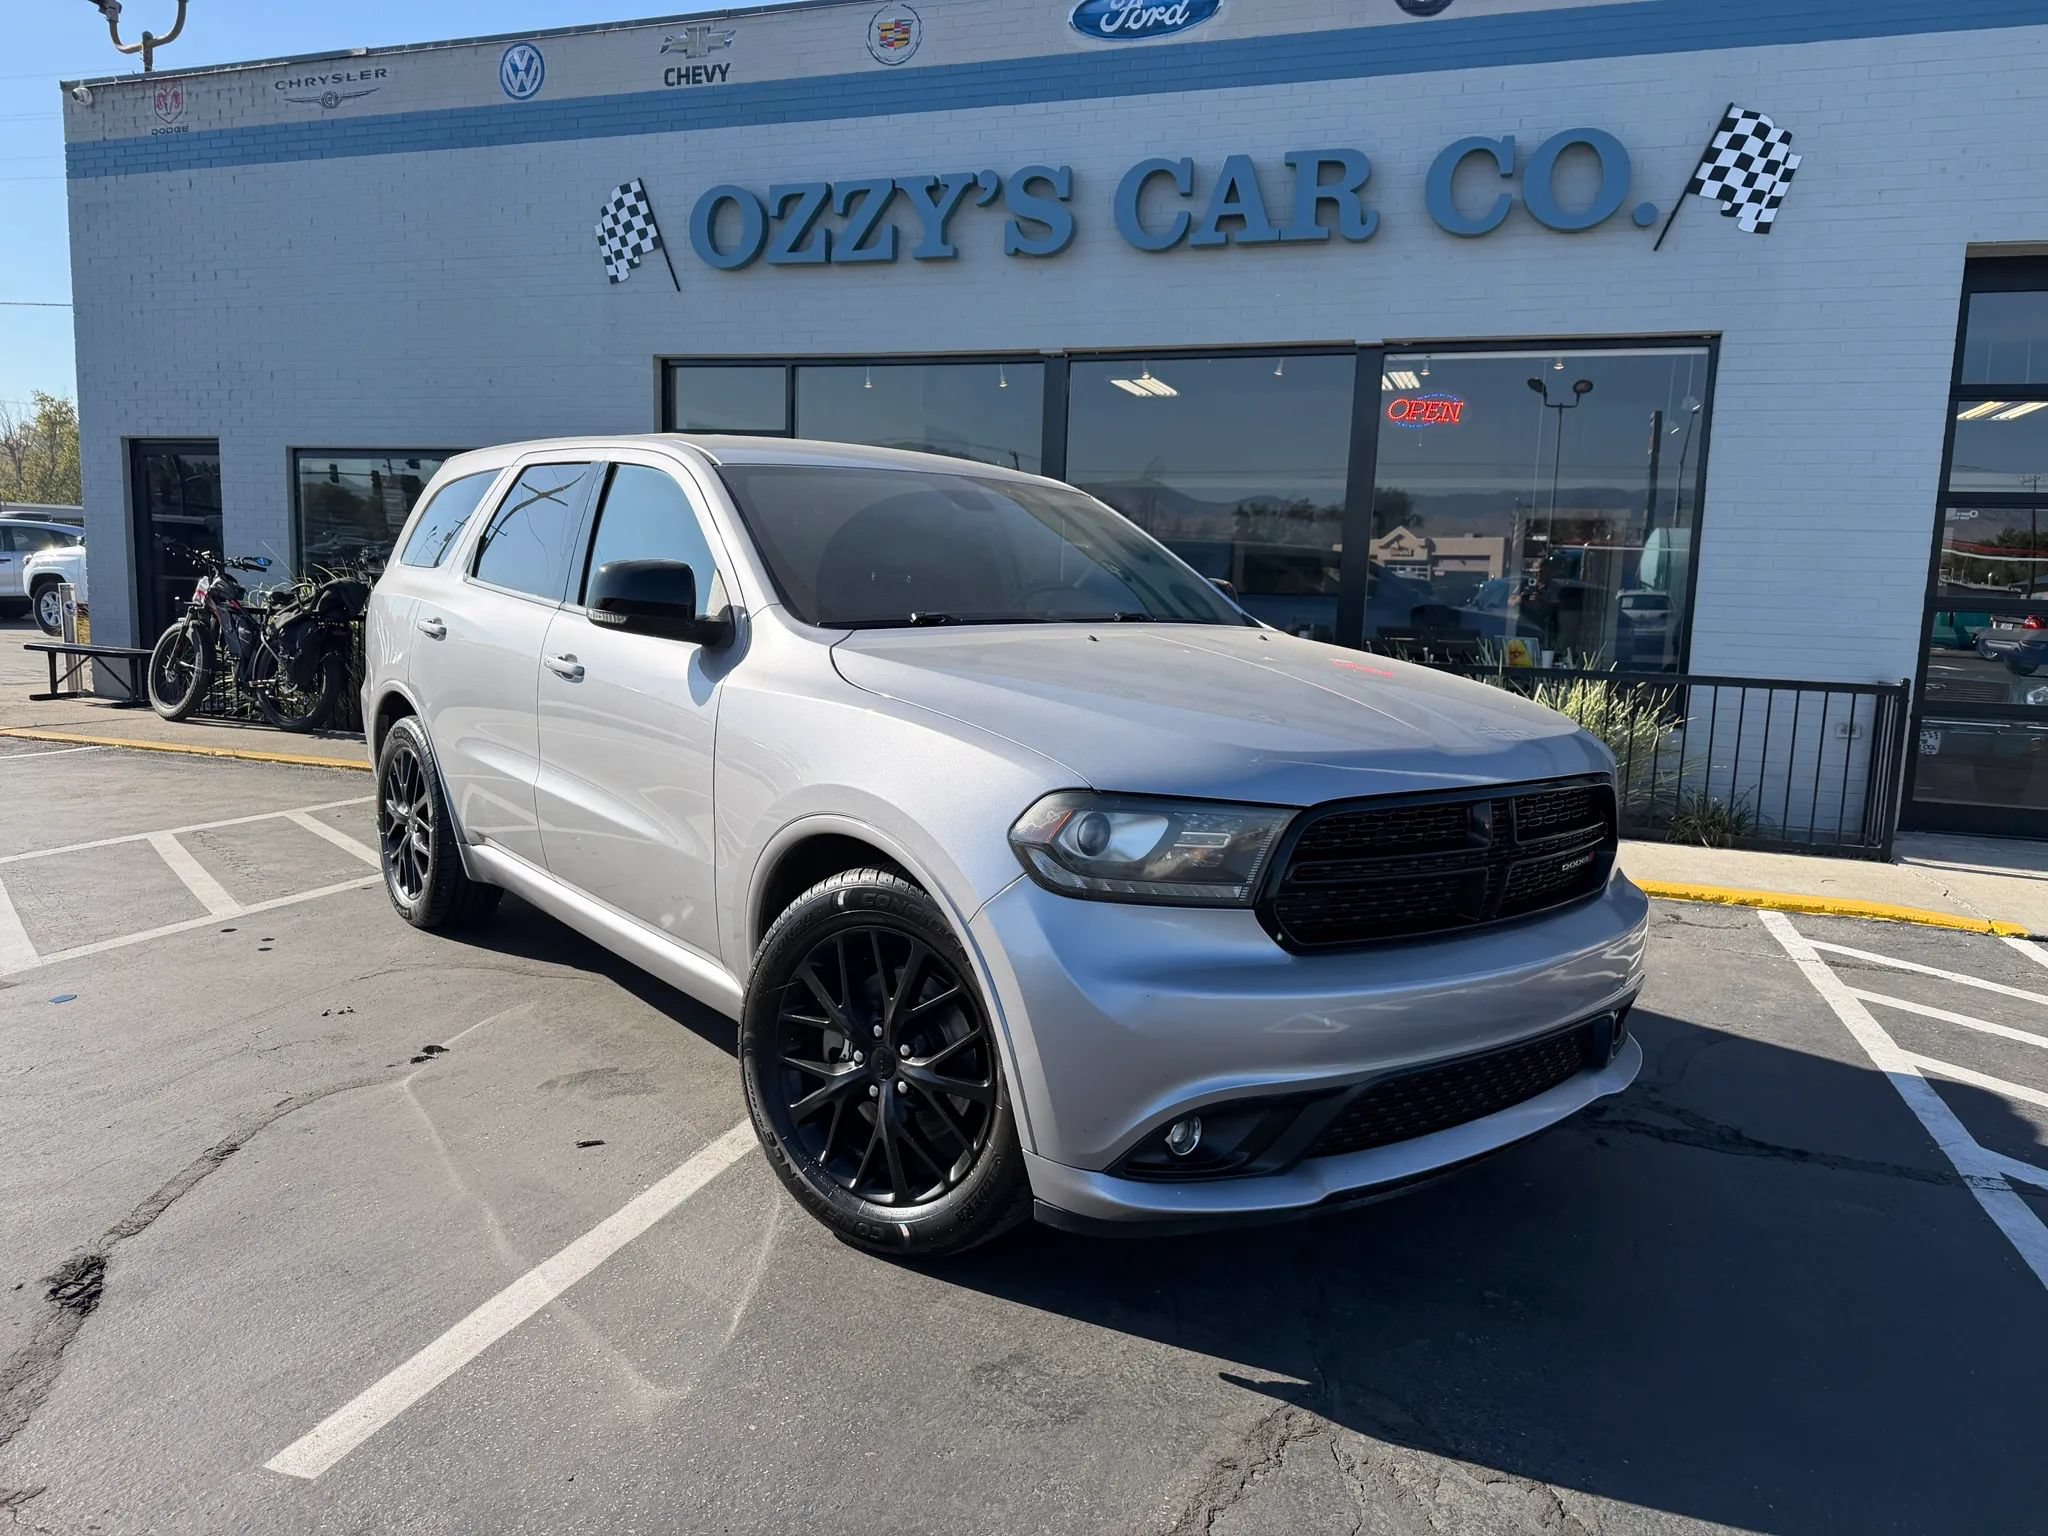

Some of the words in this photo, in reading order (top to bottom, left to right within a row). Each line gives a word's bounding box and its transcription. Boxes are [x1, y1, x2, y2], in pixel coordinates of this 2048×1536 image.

[1099, 0, 1190, 33] Ford
[275, 67, 388, 91] CHRYSLER
[664, 63, 731, 87] CHEVY
[151, 125, 190, 136] DODGE
[689, 164, 1076, 271] OZZY'S
[1112, 147, 1380, 254] CAR
[1424, 127, 1659, 239] CO.
[1388, 398, 1464, 423] OPEN
